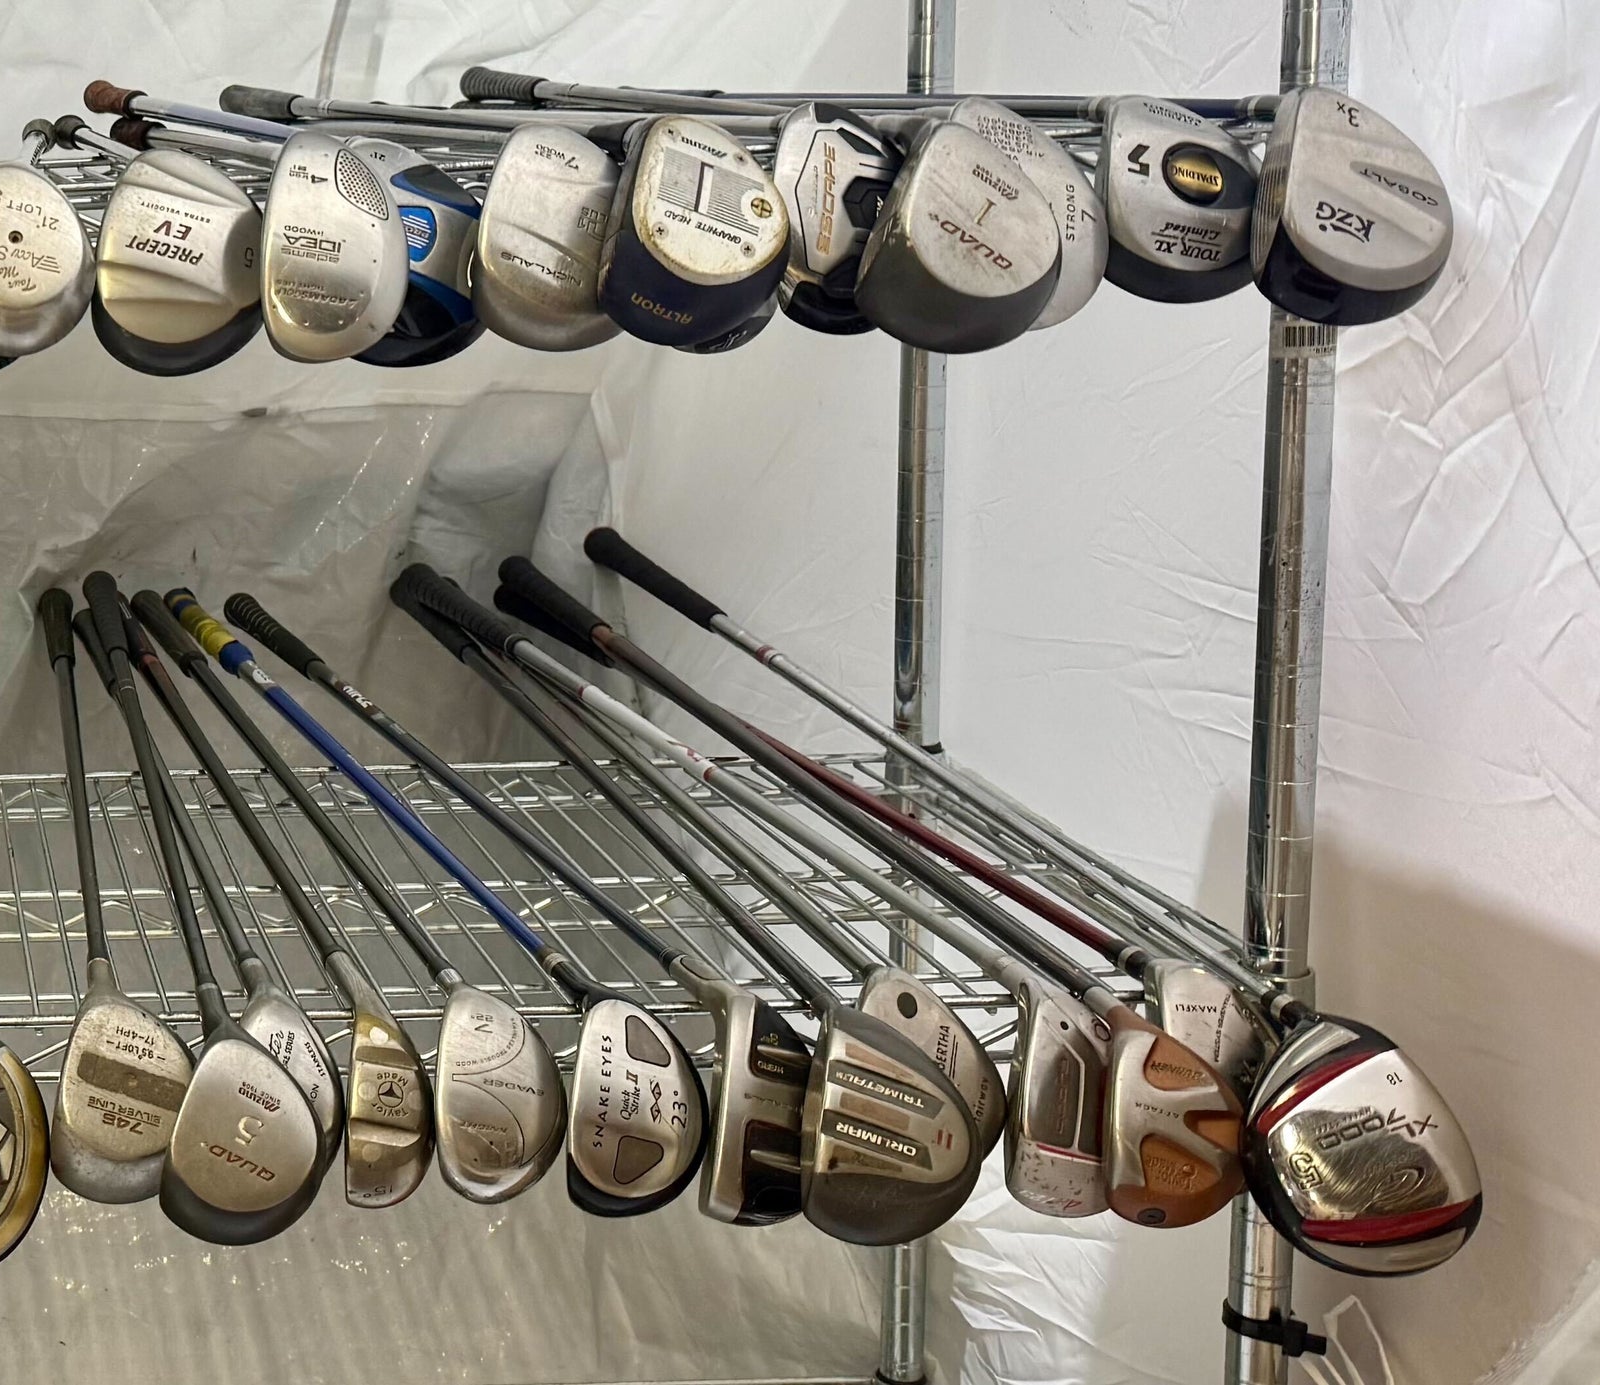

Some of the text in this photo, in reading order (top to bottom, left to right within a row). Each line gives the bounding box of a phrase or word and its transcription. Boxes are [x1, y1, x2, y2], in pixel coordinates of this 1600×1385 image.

[1127, 142, 1151, 178] 5
[1171, 162, 1219, 188] SPALDING
[815, 141, 837, 256] ESCAPE
[1358, 164, 1440, 208] COBALT
[6, 199, 43, 217] LOFT
[138, 199, 181, 219] VELOCITY
[1065, 183, 1076, 241] STRONG
[1081, 208, 1098, 223] 7
[1315, 200, 1376, 243] KZG
[152, 219, 193, 241] EV
[283, 233, 342, 254] IDEA
[663, 208, 743, 246] GRAPHITE HEAD
[1162, 219, 1221, 241] Limited
[123, 231, 205, 268] PRECEPT
[280, 248, 340, 265] adams
[939, 218, 1014, 272] QUAD
[1155, 238, 1221, 263] TOUR XL
[500, 251, 583, 288] NICKLAUS
[629, 291, 694, 325] ALTRON
[1173, 1003, 1218, 1015] MAXFLI
[304, 1041, 327, 1078] STAINLESS
[455, 1058, 479, 1068] WOOD
[1151, 1060, 1204, 1079] BURNER
[375, 1071, 410, 1089] Made
[482, 1077, 545, 1097] EVADER
[592, 1033, 613, 1148] SNAKE EYES
[1385, 1070, 1403, 1086] 18
[87, 1095, 162, 1125] SILVER LINE
[237, 1087, 281, 1114] MIZUNO
[370, 1100, 409, 1120] Taylor
[620, 1088, 632, 1121] Quick
[630, 1082, 641, 1119] Strike
[669, 1090, 688, 1130] 23°
[236, 1114, 264, 1147] 5
[835, 1120, 918, 1157] ORLIMAR
[1317, 1107, 1406, 1150] 7000
[1390, 1114, 1440, 1139] XL
[208, 1141, 277, 1184] QUAD
[1289, 1152, 1323, 1190] 5
